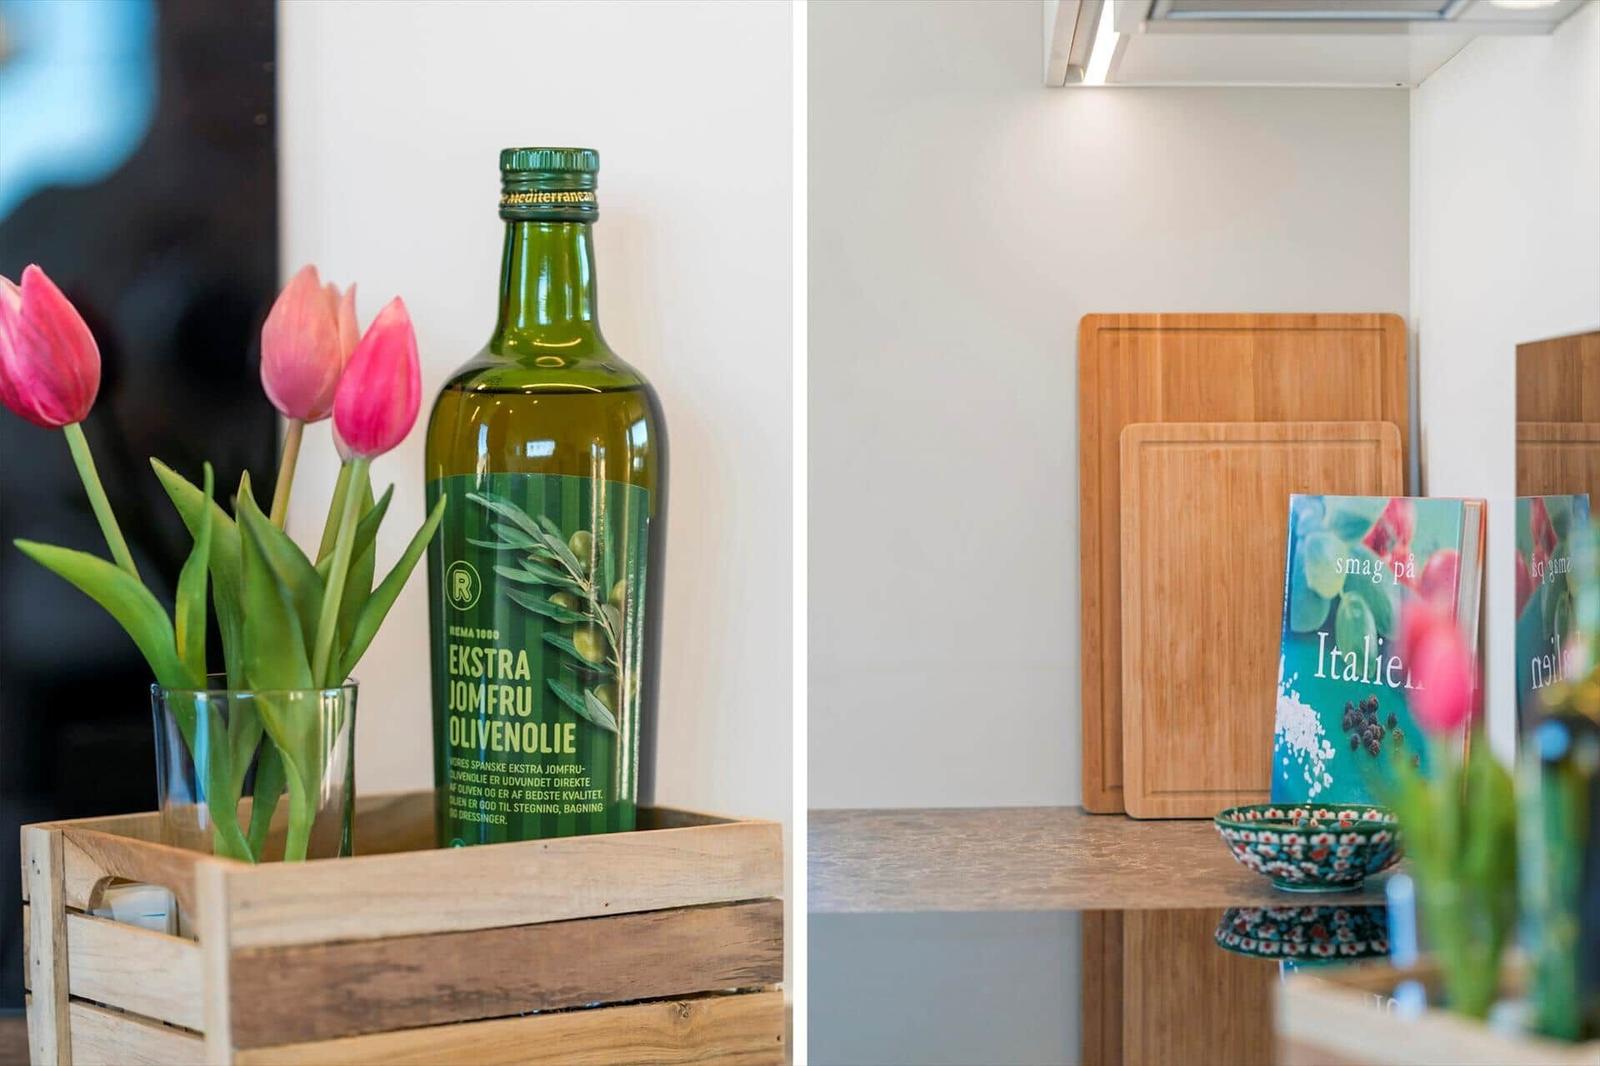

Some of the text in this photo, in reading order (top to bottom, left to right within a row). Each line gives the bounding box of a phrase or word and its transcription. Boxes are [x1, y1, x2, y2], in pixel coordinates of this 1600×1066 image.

[507, 188, 595, 204] Mediterranean
[1335, 553, 1416, 585] smag på
[453, 569, 473, 602] R
[476, 628, 500, 640] 1000
[449, 644, 531, 681] EKSTRA
[448, 680, 533, 718] JOMFRU
[449, 715, 577, 755] OLIVENOLIE
[470, 760, 508, 773] SPANSKE
[508, 763, 544, 775] EKSTRA
[544, 764, 586, 775] JOMFRU-
[489, 775, 501, 785] ER
[502, 777, 552, 788] UDVUNDET
[553, 777, 591, 788] DIREKTE
[457, 784, 483, 797] OLIVEN
[484, 787, 496, 798] OG
[497, 789, 510, 799] ER
[511, 790, 523, 800] AF
[525, 790, 561, 801] BEDSTE
[562, 790, 604, 801] KVALITET.
[468, 798, 478, 809] ER
[479, 800, 497, 811] GOD
[498, 802, 512, 812] TIL
[513, 803, 562, 815] STEGNING,
[563, 802, 604, 814] BAGNING
